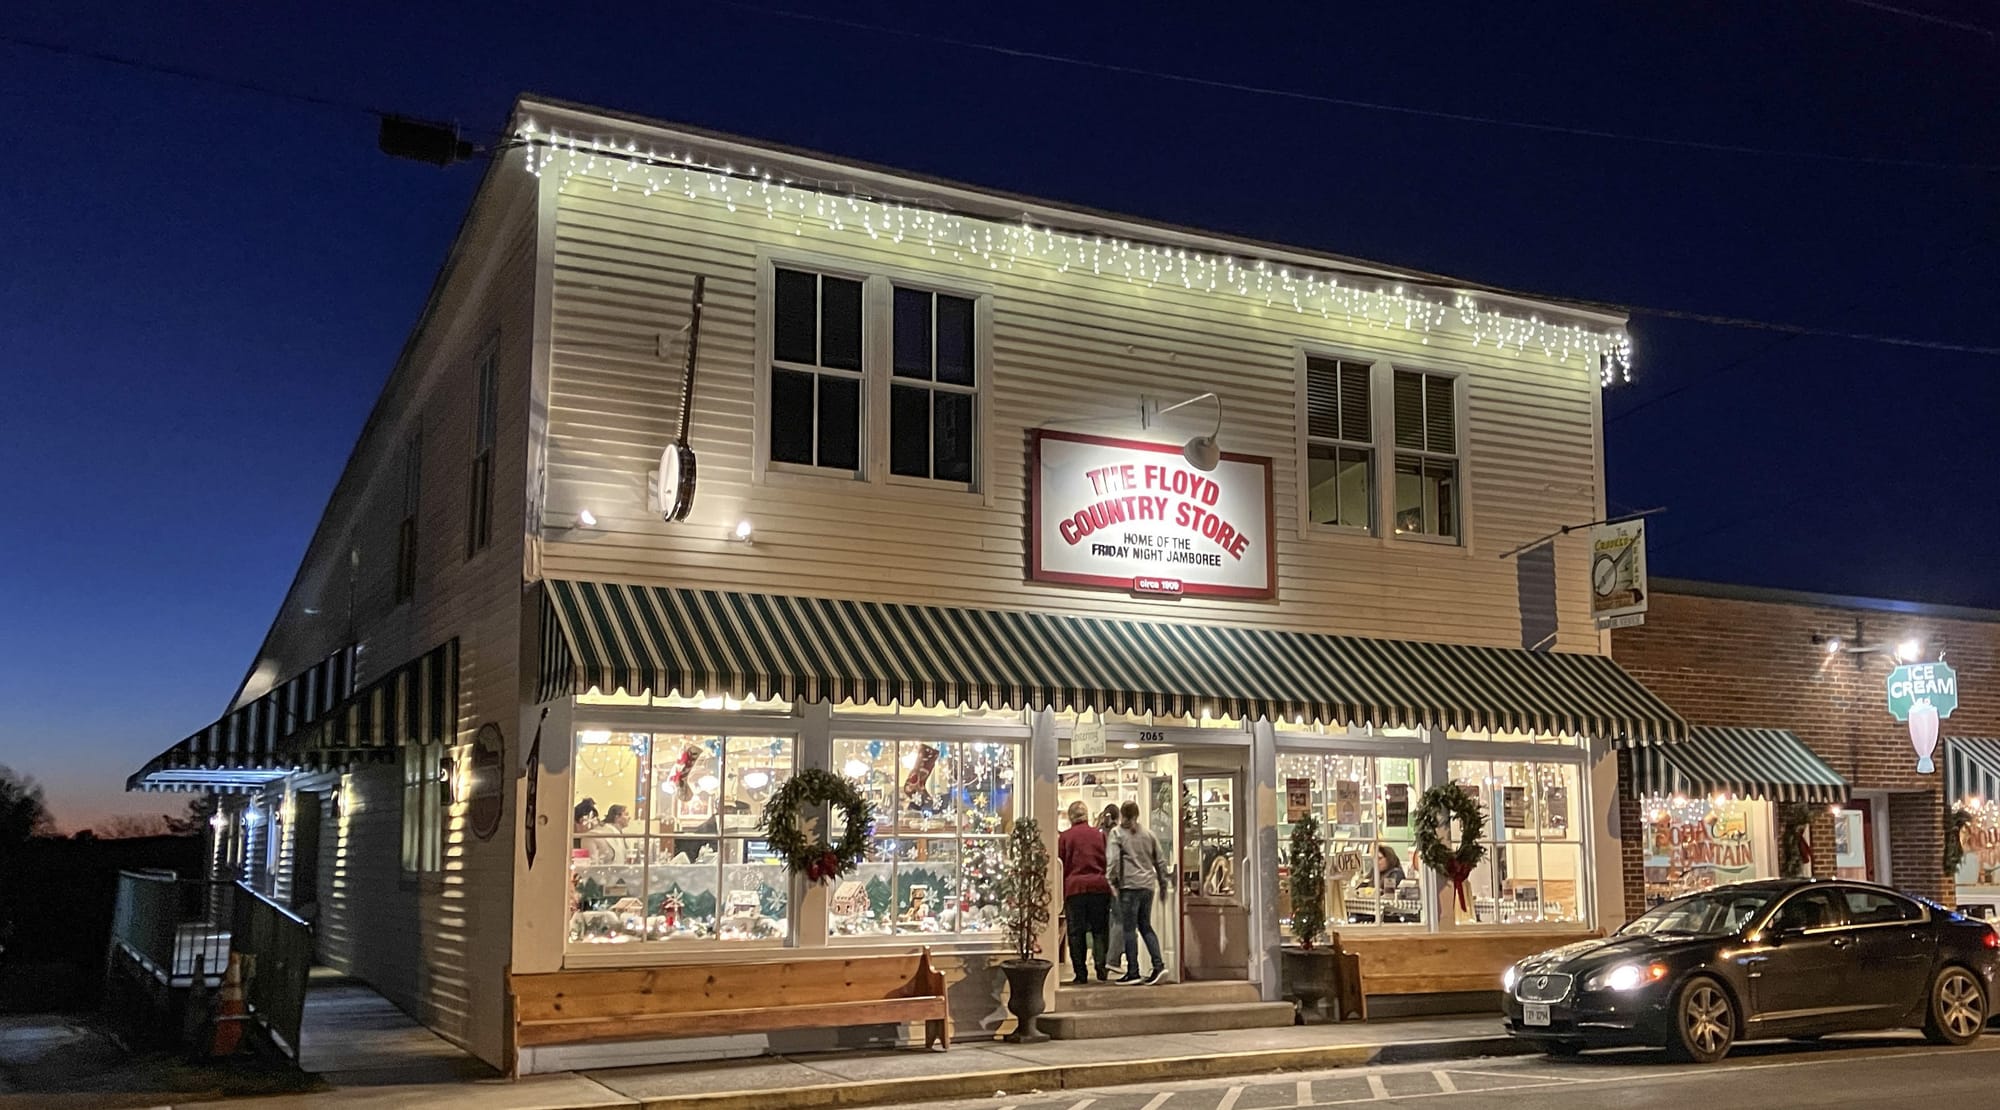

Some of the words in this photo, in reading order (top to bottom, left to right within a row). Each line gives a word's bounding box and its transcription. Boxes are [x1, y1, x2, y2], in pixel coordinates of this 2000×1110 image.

[1086, 465, 1137, 497] THE
[1144, 465, 1220, 507] FLOYD
[1059, 496, 1169, 546] COUNTRY
[1175, 501, 1250, 562] STORE
[1124, 533, 1153, 547] HOME
[1157, 536, 1169, 549] OF
[1171, 538, 1191, 550] THE
[1092, 544, 1130, 558] FRIDAY
[1133, 549, 1163, 562] NIGHT
[1167, 552, 1221, 567] JAMBOREE
[1140, 579, 1159, 589] circa
[1908, 666, 1934, 681] ICE
[1890, 678, 1954, 698] CREAM
[1140, 732, 1164, 741] 2065
[1338, 853, 1361, 871] OPEN
